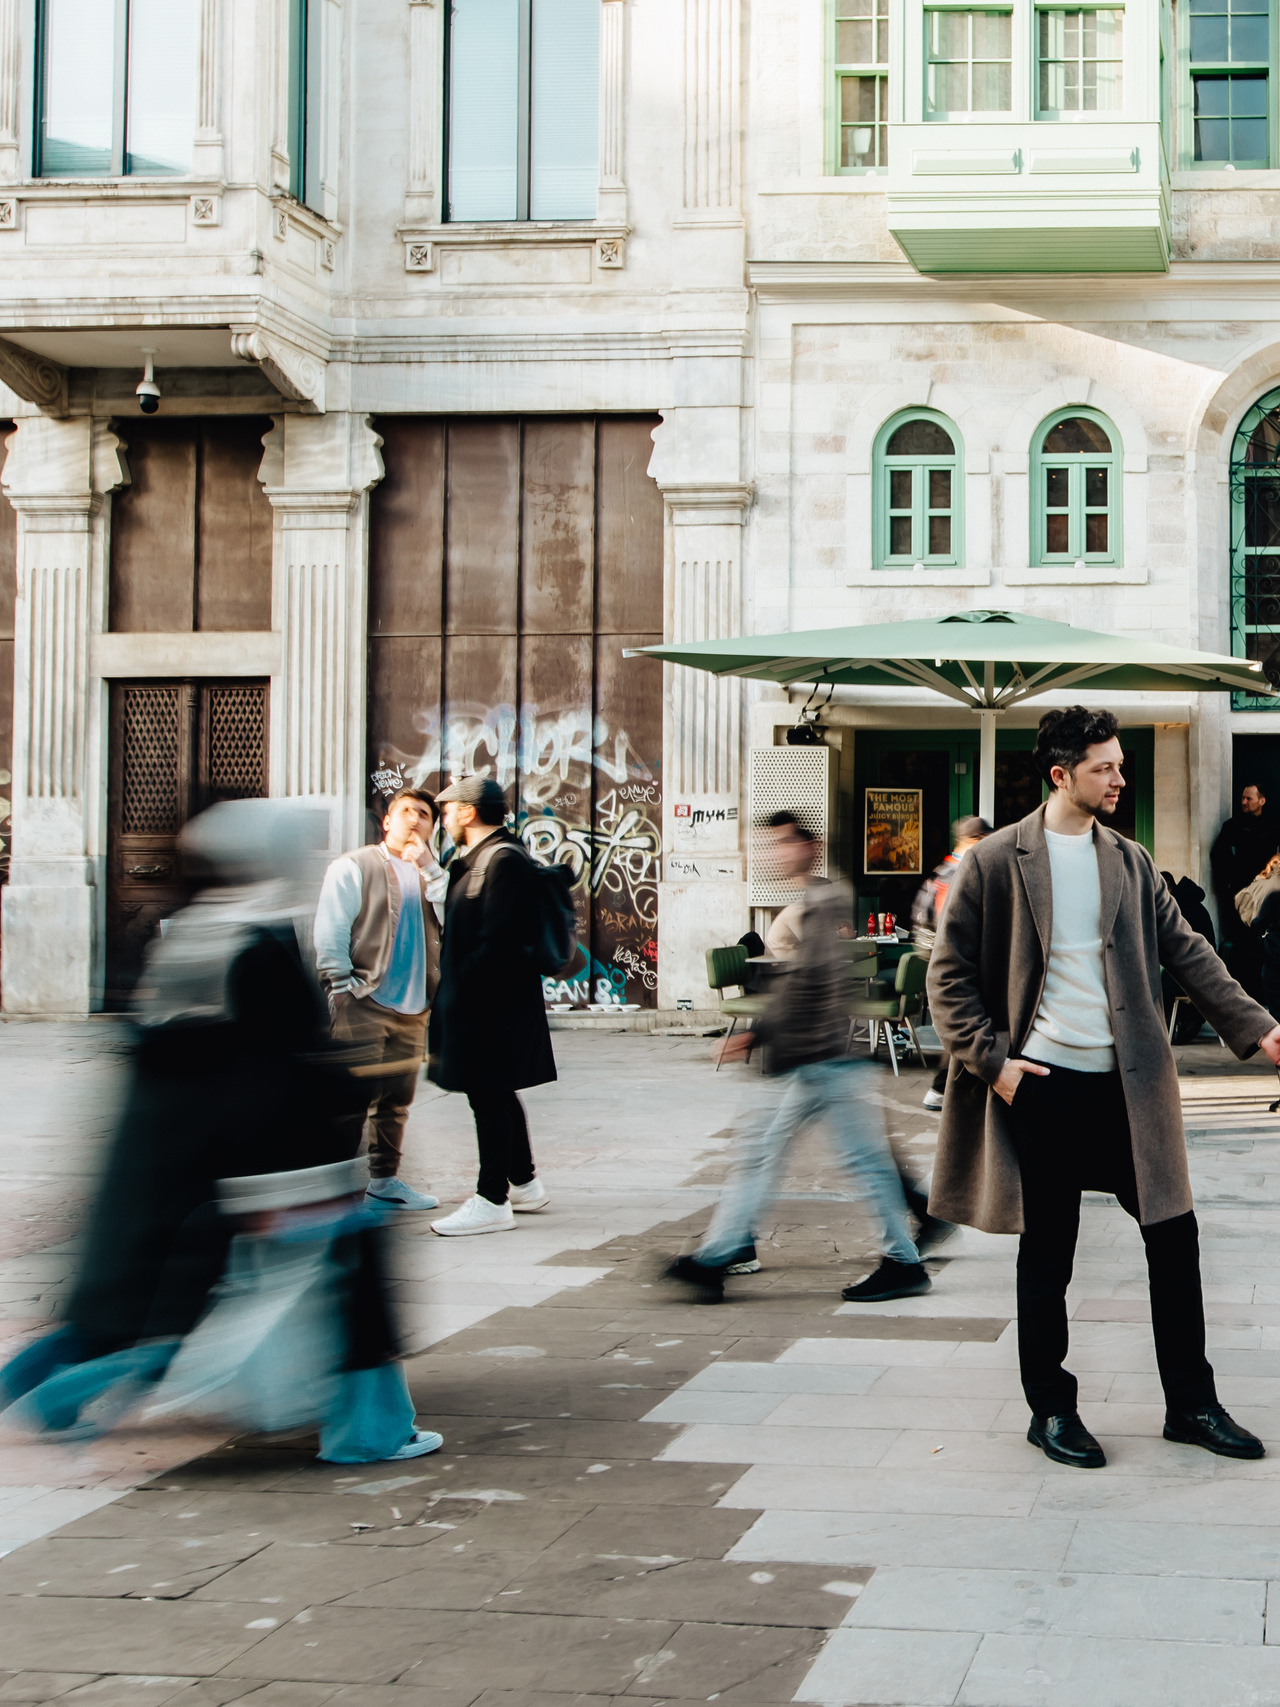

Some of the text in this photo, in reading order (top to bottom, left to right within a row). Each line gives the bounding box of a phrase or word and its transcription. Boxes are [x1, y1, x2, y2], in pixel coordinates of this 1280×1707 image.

[868, 792, 919, 803] THE MOST
[873, 802, 915, 812] FAMOUS
[868, 812, 891, 820] JUICY
